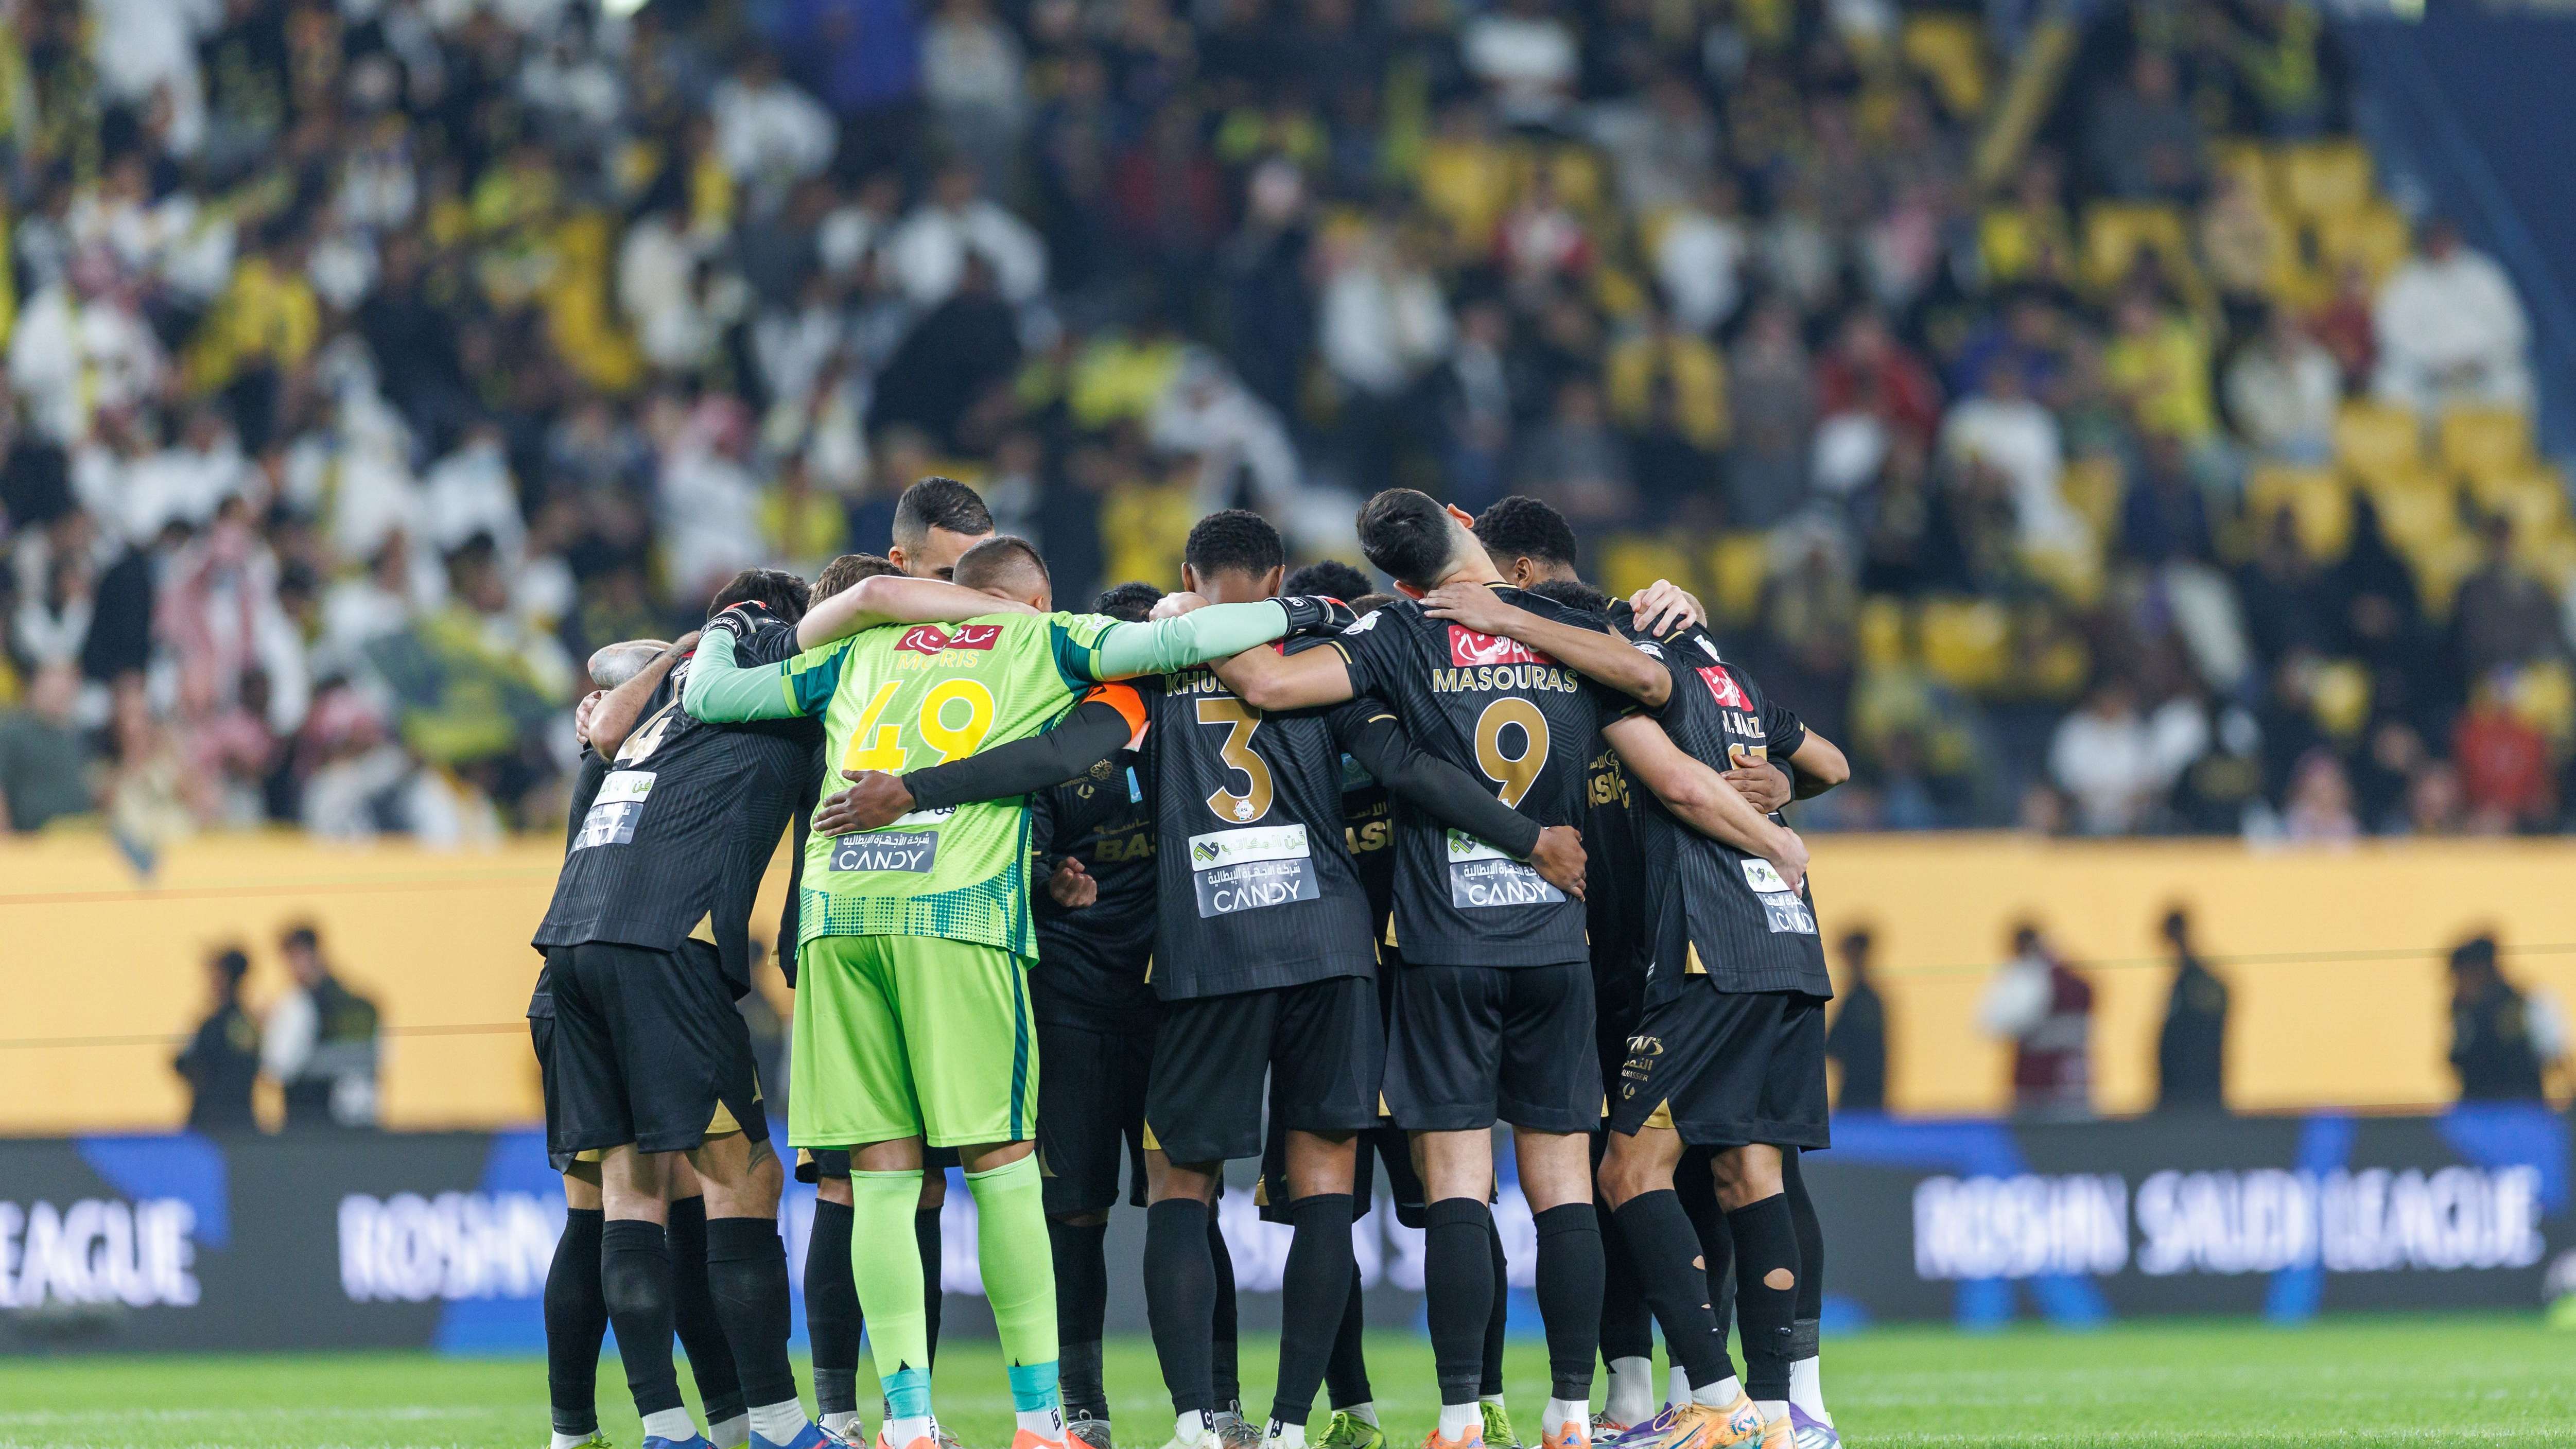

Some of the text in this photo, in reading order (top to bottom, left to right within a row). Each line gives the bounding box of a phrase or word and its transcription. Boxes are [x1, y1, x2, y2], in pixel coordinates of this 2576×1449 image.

[1433, 666, 1578, 693] MASOURAS
[841, 677, 996, 777] 49
[1196, 697, 1273, 824] 3
[1474, 697, 1550, 810] 9
[874, 834, 907, 848] الأجهزة
[907, 833, 930, 846] شركة
[1284, 831, 1306, 849] فن
[839, 850, 925, 870] CANDY
[1243, 863, 1275, 881] الأجهزة
[1276, 861, 1301, 877] شركة
[1213, 880, 1301, 913] CANDY
[1468, 881, 1547, 906] CANDY
[2322, 1165, 2545, 1270] LEAGUE
